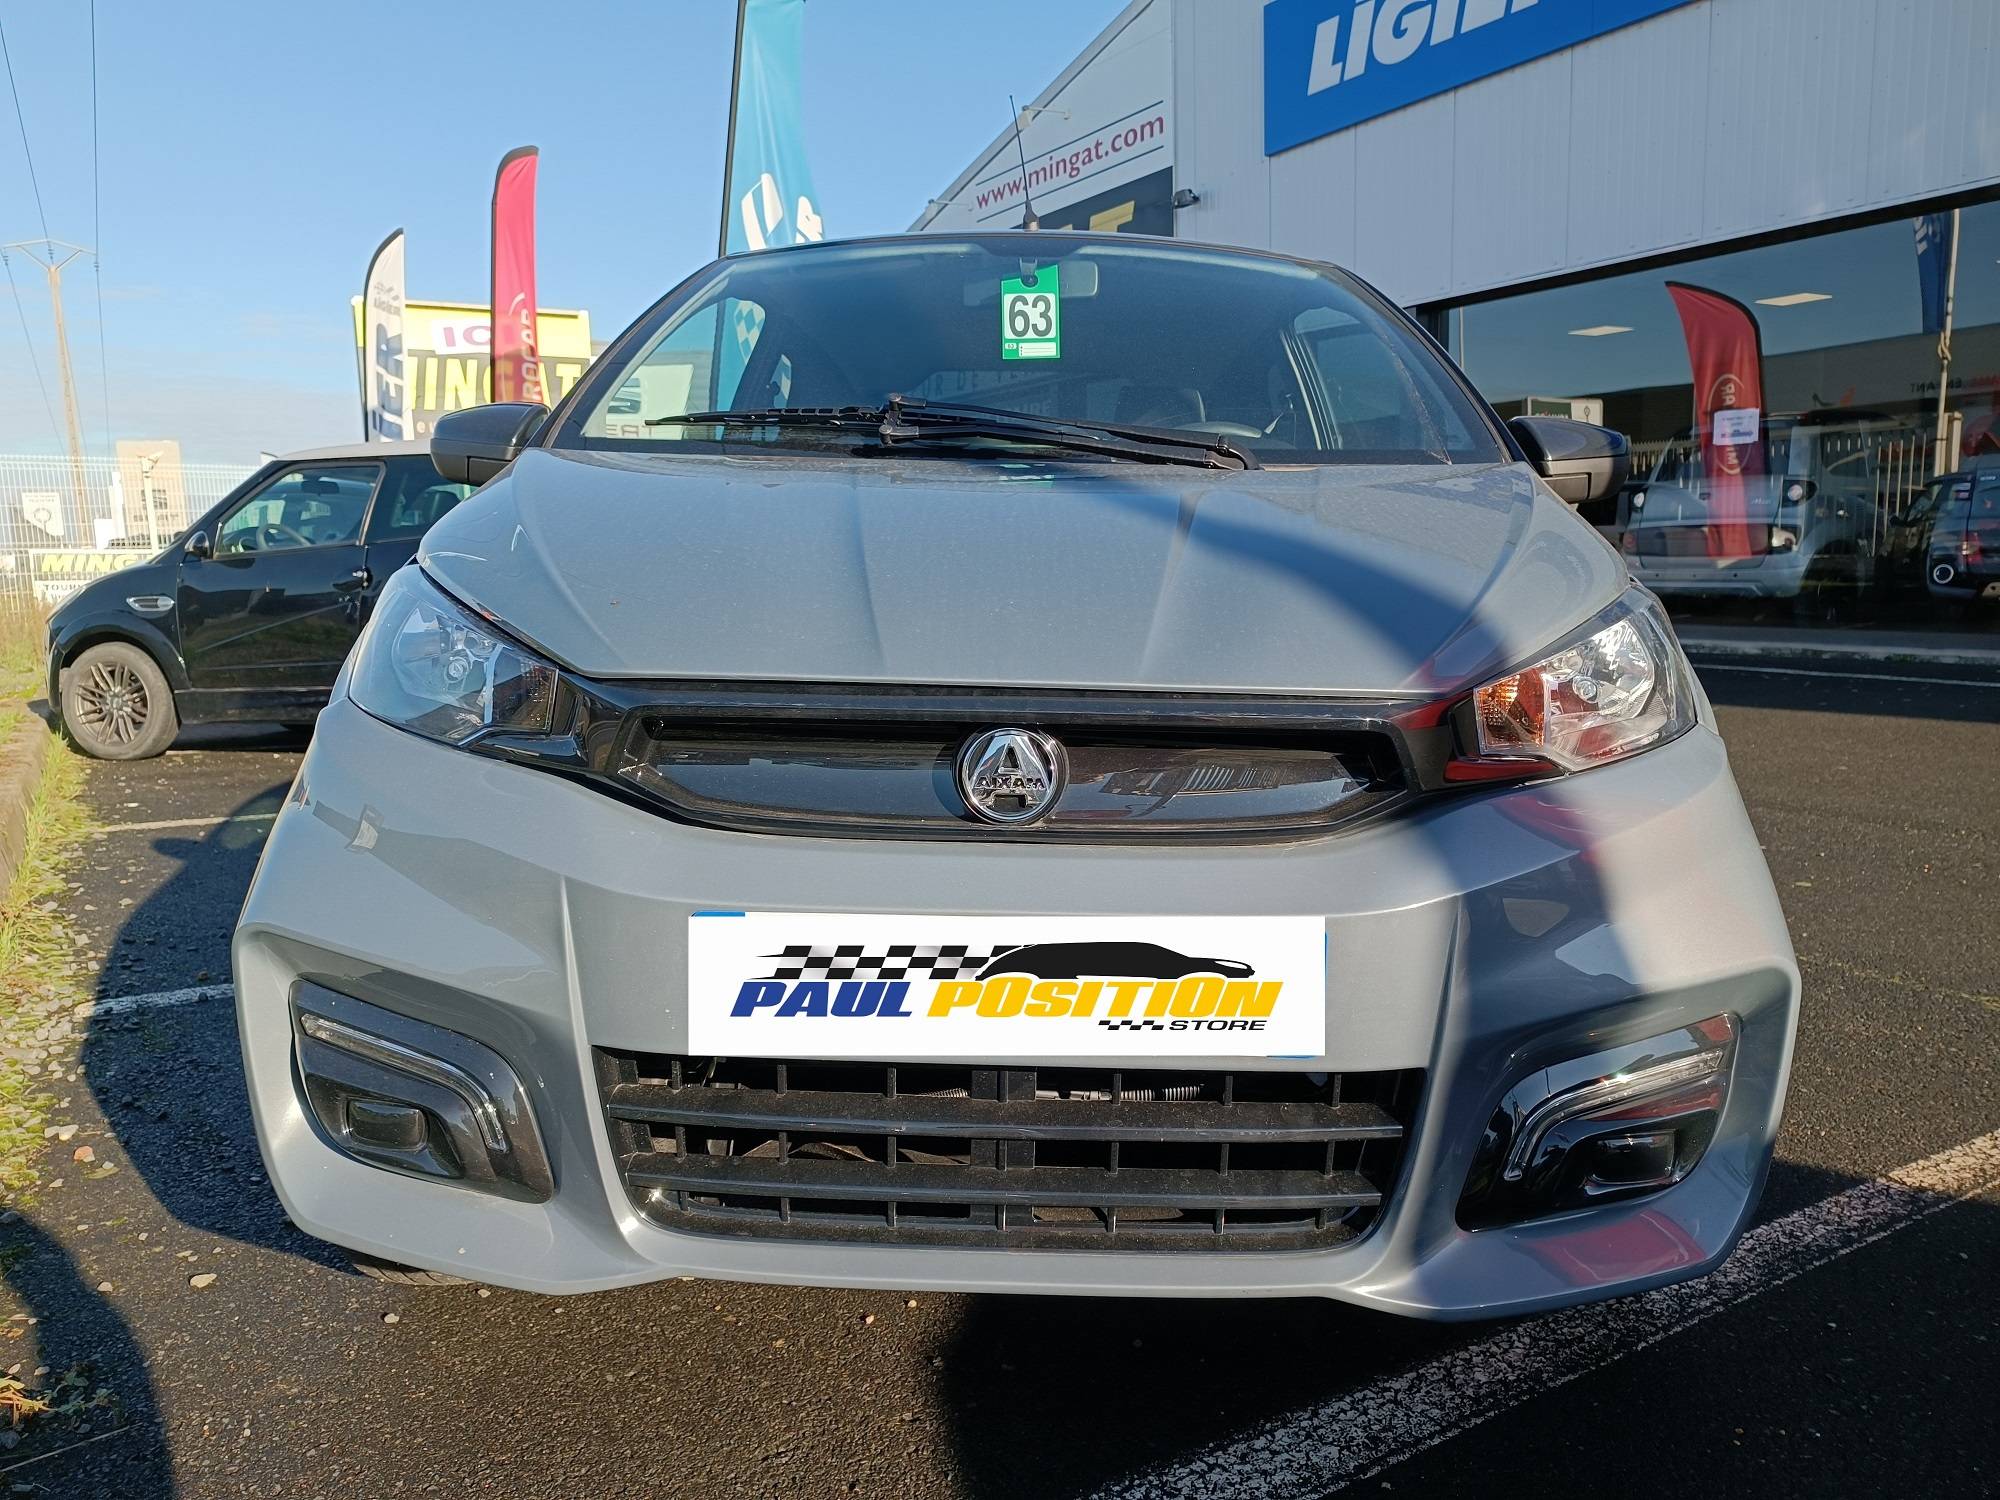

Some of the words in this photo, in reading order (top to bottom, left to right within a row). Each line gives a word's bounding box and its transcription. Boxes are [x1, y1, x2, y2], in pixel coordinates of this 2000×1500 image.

[1307, 0, 1538, 96] LIGI
[976, 115, 1165, 210] www.mingat.com
[1008, 294, 1053, 338] 63
